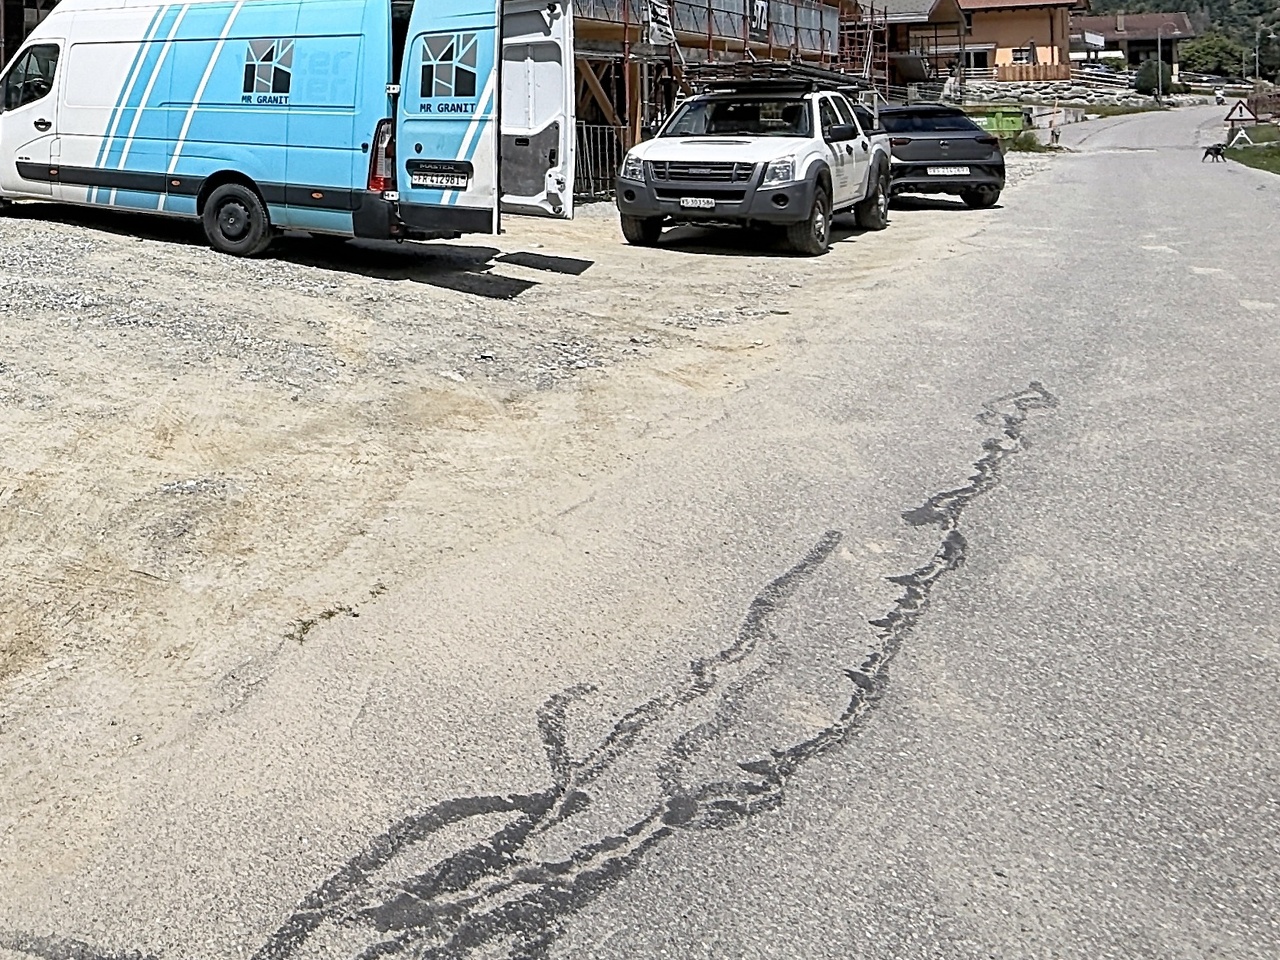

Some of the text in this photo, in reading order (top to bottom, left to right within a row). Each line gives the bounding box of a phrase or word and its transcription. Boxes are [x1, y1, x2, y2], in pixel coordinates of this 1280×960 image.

[241, 95, 290, 105] MR GRANIT
[419, 103, 476, 113] MR GRANIT
